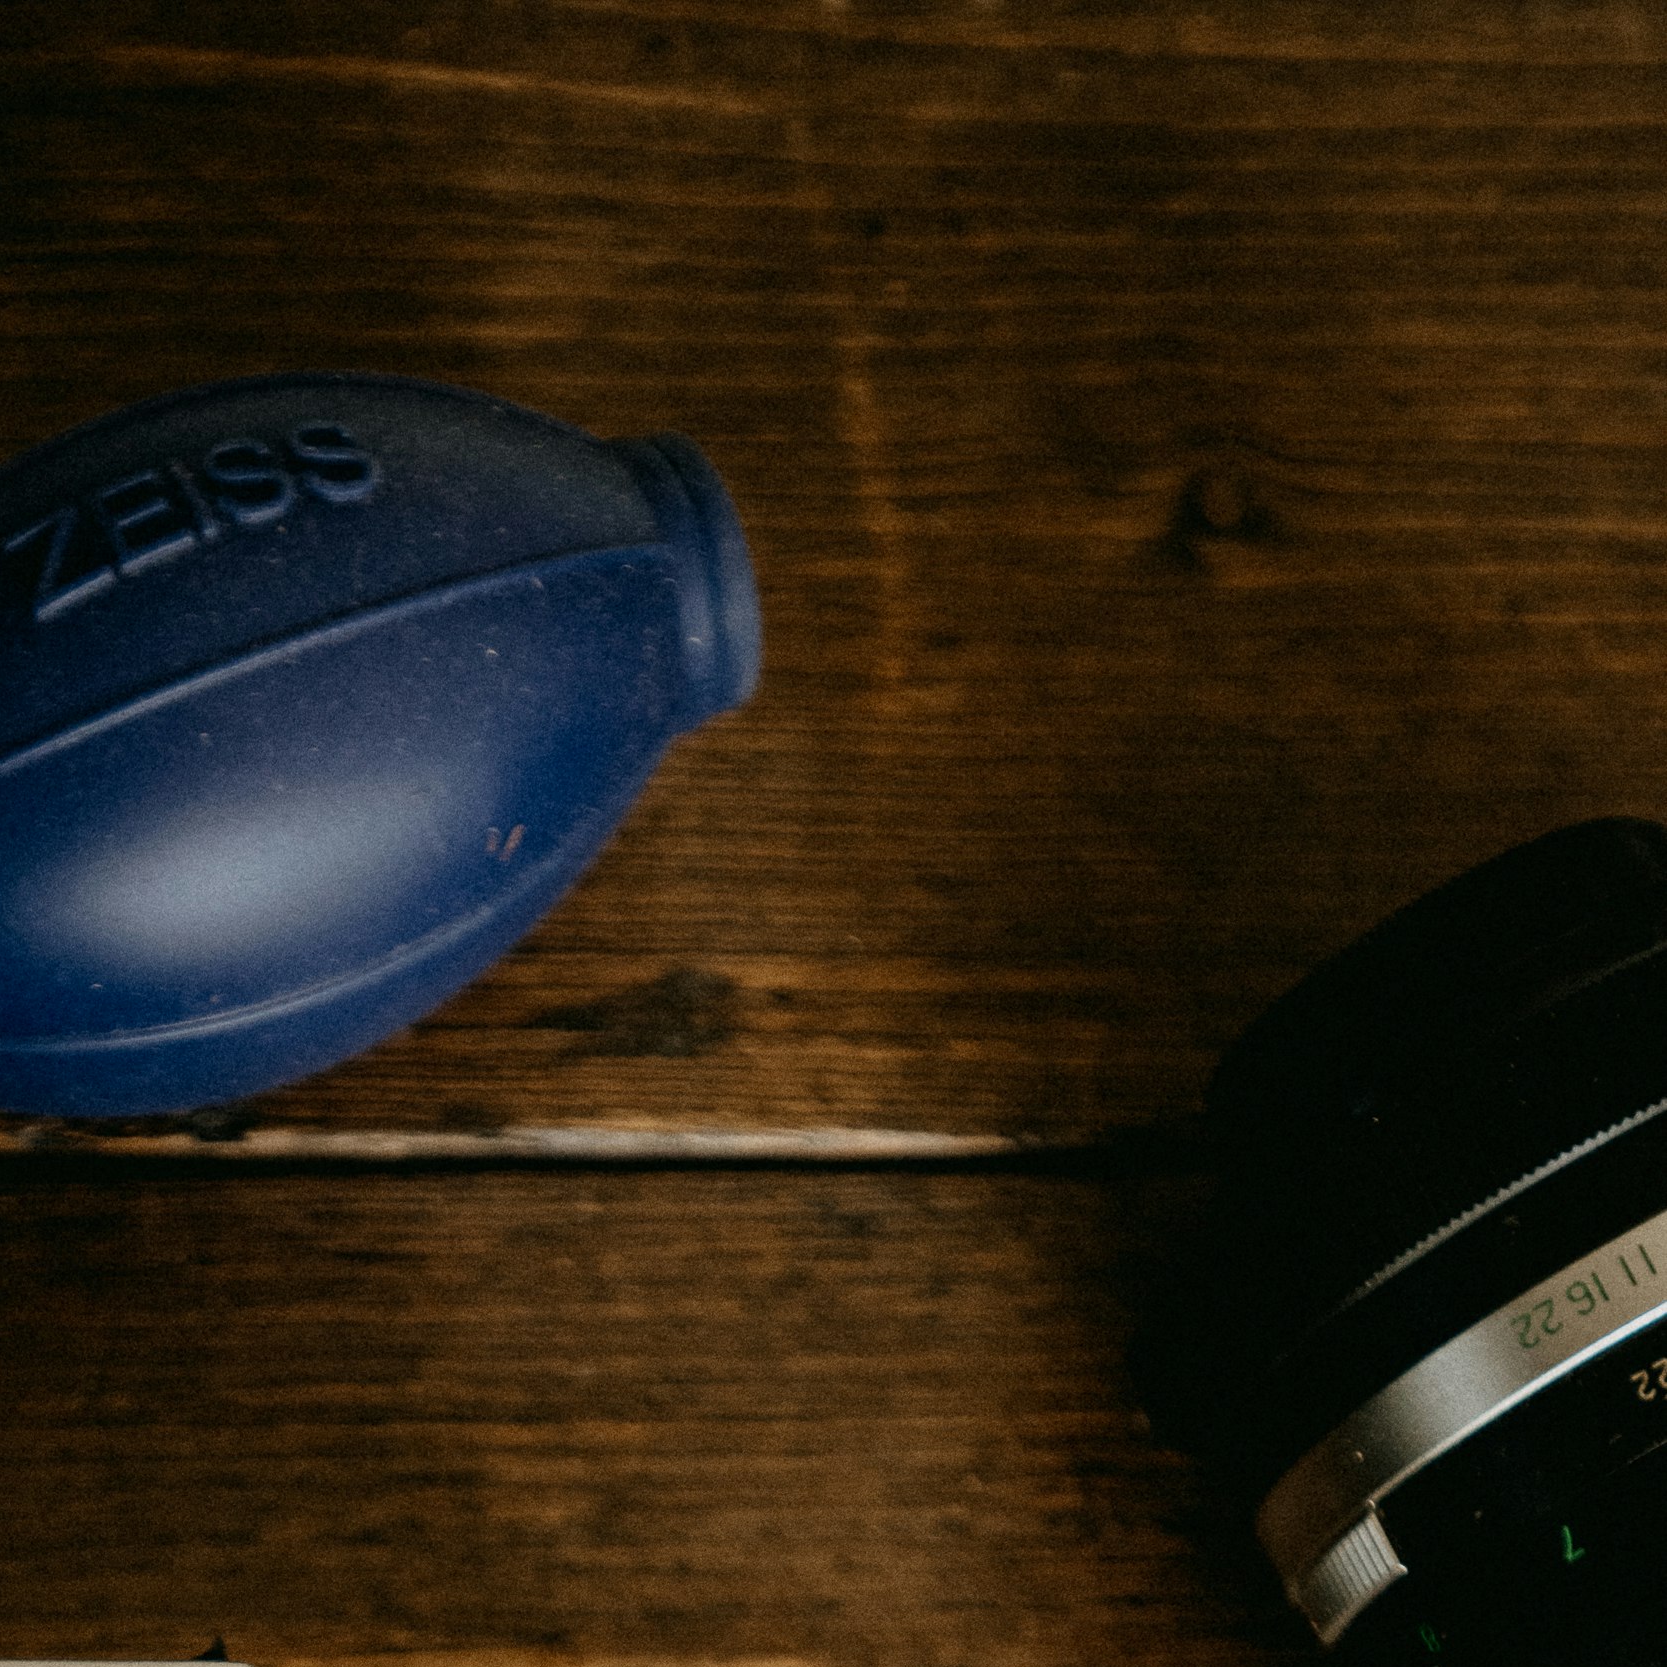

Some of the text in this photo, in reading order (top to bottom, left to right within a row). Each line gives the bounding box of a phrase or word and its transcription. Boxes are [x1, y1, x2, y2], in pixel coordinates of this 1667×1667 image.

[3, 422, 381, 625] ZEISS
[1510, 1243, 1658, 1350] 11 16 22
